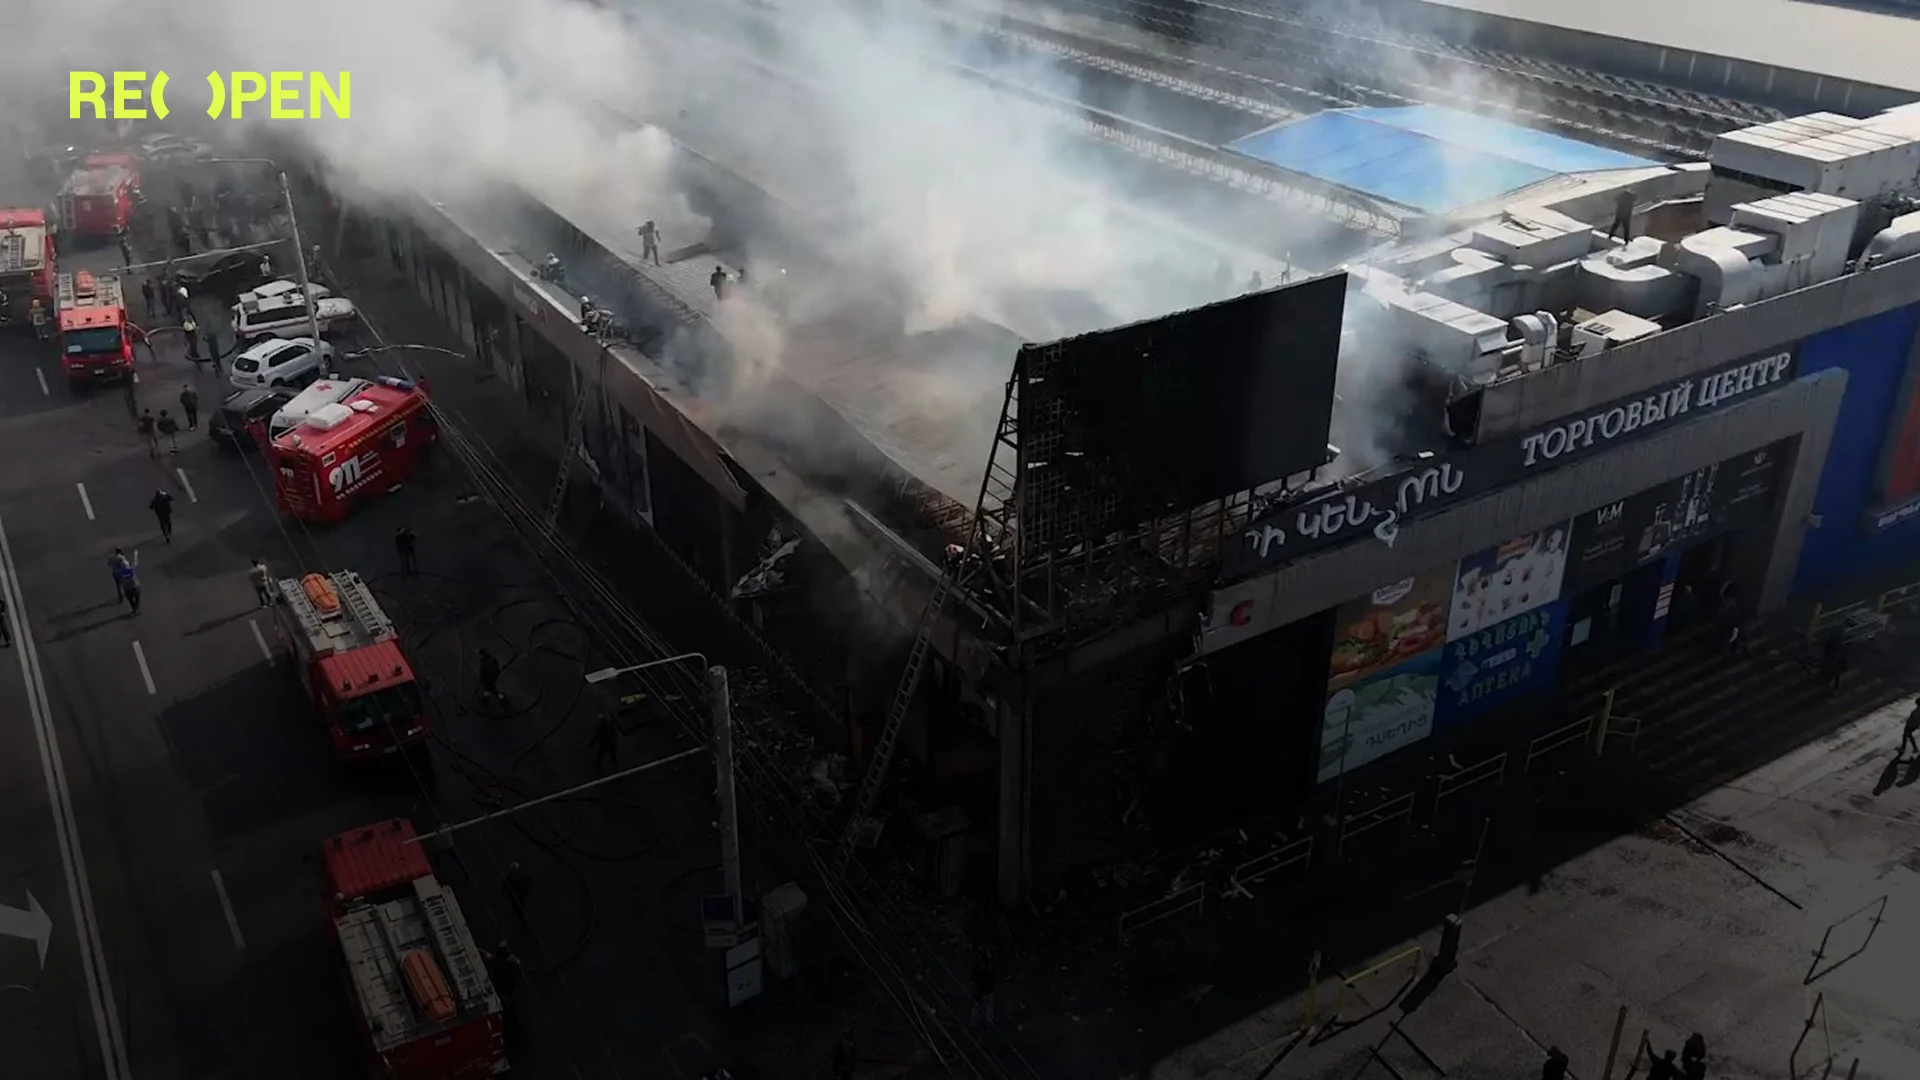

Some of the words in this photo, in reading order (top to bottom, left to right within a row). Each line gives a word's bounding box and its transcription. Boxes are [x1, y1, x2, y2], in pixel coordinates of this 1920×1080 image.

[1521, 380, 1694, 467] ТОРГОВЫЙ
[1697, 352, 1792, 407] ЦЕНТР
[328, 455, 362, 494] 911
[1457, 661, 1533, 708] АПТЕКА
